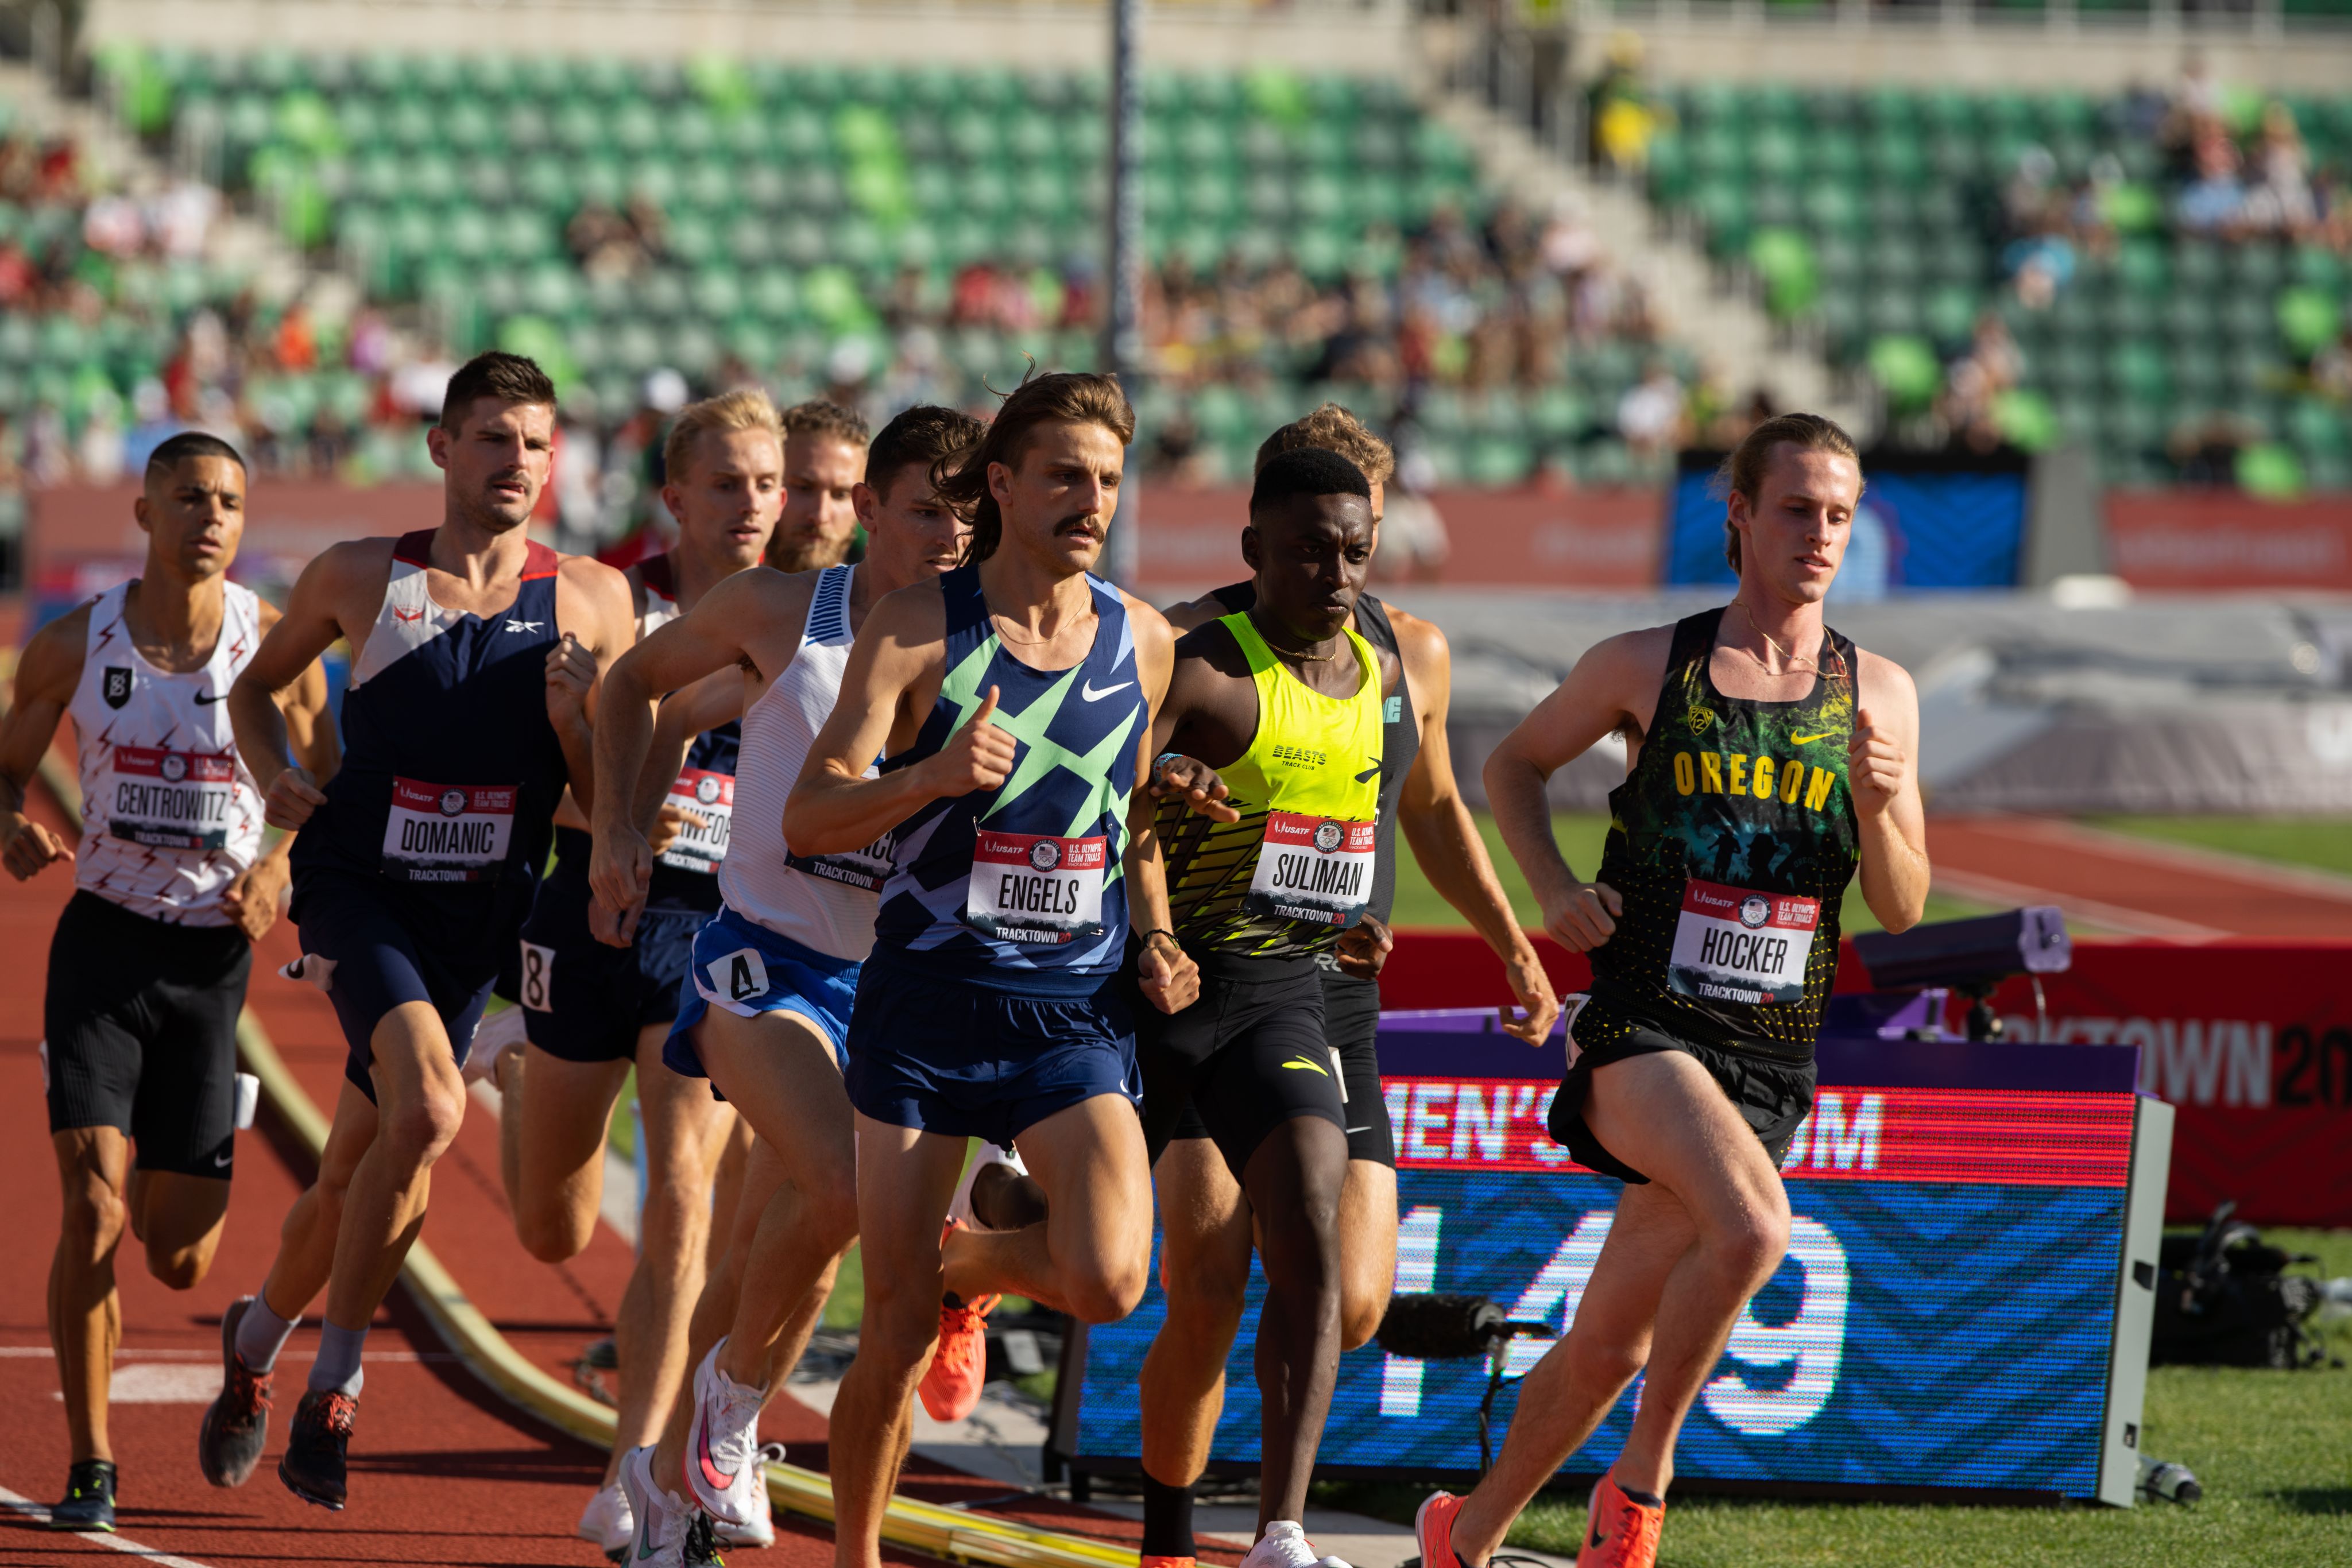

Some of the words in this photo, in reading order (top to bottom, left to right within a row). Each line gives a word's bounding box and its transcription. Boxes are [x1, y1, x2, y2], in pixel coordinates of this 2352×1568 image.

[1693, 719, 1705, 729] 12
[1272, 745, 1327, 765] BEASTS
[1674, 752, 1836, 812] OREGON
[117, 781, 228, 822] CENTROWITZ
[401, 818, 494, 854] DOMANIC
[1285, 826, 1310, 835] USATF
[1351, 827, 1361, 836] U.S.
[1069, 844, 1080, 853] U.S.
[1081, 843, 1102, 853] OLYMPIC
[1349, 836, 1363, 845] TEAM
[996, 845, 1024, 854] USATF
[1068, 853, 1084, 862] TEAM
[1085, 852, 1101, 862] TRIALS
[1272, 853, 1364, 896] SULIMAN
[998, 874, 1080, 915] ENGELS
[1705, 897, 1734, 908] USATF
[1274, 905, 1345, 924] TRACKTOWN20
[1779, 901, 1790, 912] U.S.
[1792, 903, 1816, 915] OLYMPIC
[1777, 911, 1793, 921] TEAM
[1793, 913, 1813, 924] TRIALS
[996, 927, 1071, 943] TRACKTOWN20
[1700, 927, 1788, 974] HOCKER
[527, 948, 544, 1007] 8
[730, 954, 761, 1001] 4
[1698, 982, 1774, 1005] TRACKTOWN20
